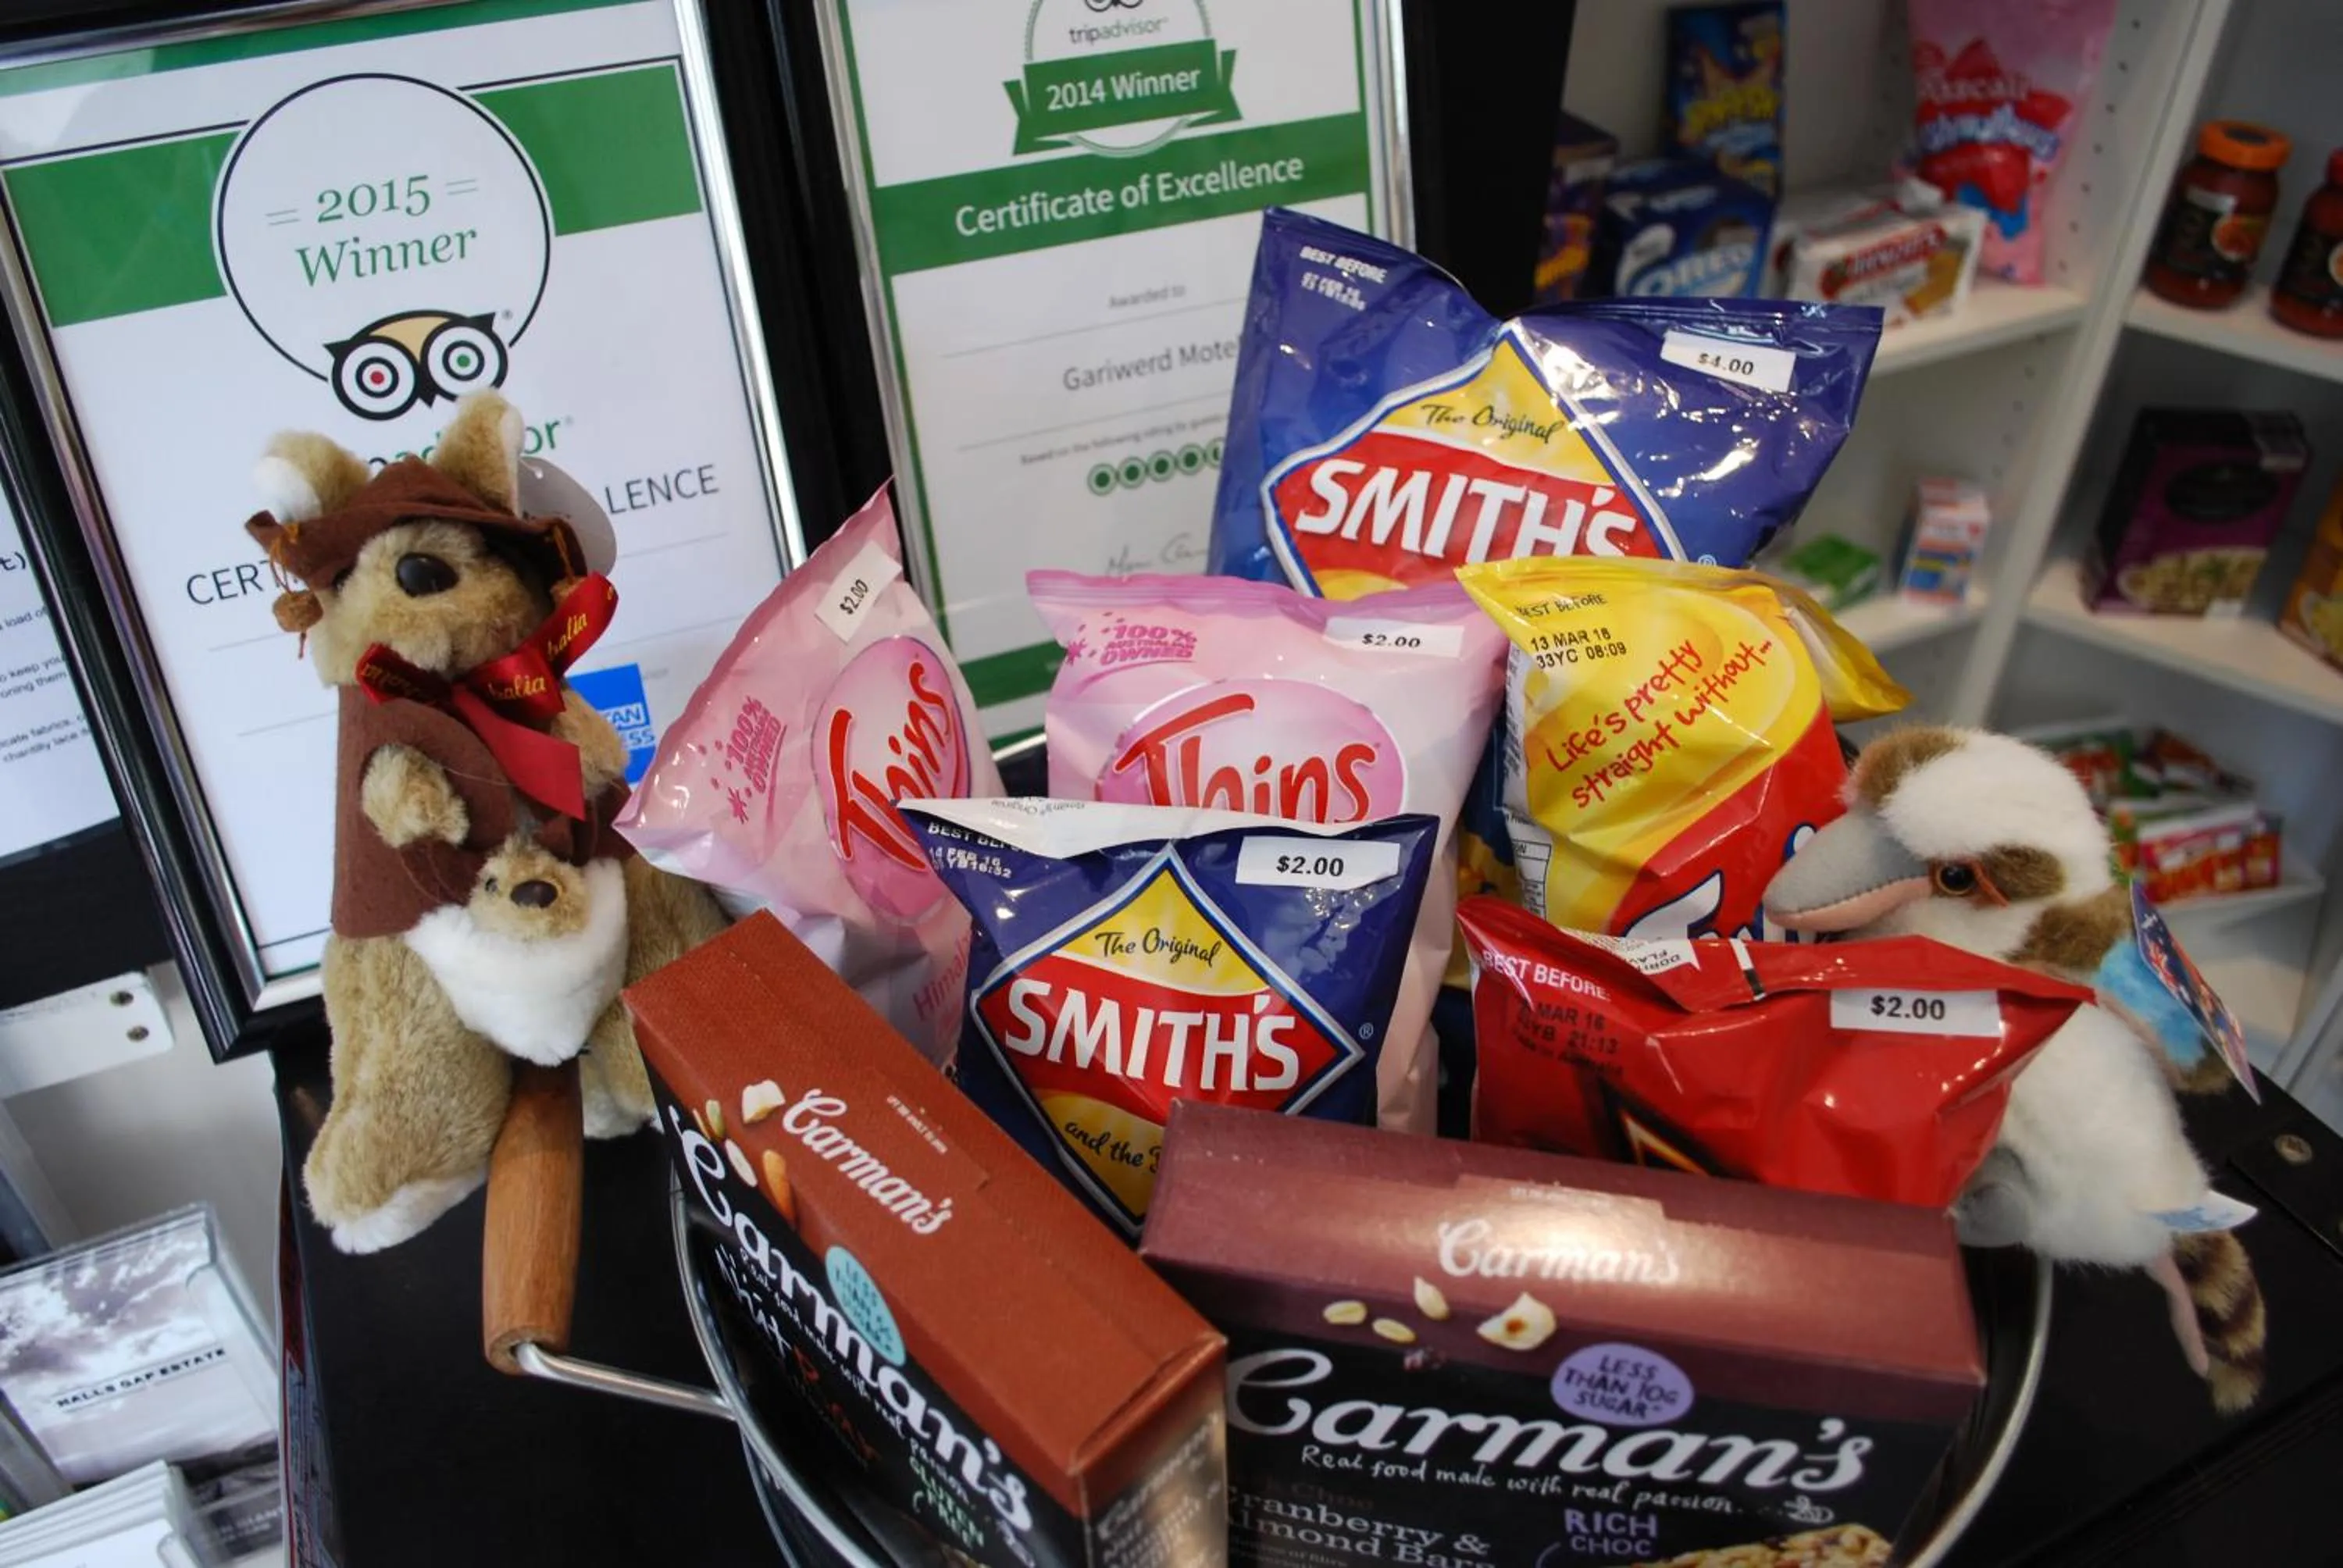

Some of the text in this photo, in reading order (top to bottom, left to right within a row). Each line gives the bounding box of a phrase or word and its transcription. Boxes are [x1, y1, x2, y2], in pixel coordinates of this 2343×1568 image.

[1069, 17, 1168, 45] tripadvisor
[1047, 68, 1200, 109] 2014 Winner
[316, 175, 432, 223] 2015
[956, 158, 1304, 236] Certificate of Excellence
[295, 228, 476, 287] Winner
[1109, 285, 1186, 308] Awarded to
[1063, 349, 1172, 391] Gariwerd
[1697, 350, 1754, 376] $4.00
[1421, 403, 1568, 445] The Original
[1296, 459, 1638, 562] SMITH'S
[840, 579, 870, 615] $2.00
[1114, 624, 1197, 643] 100%
[1362, 633, 1421, 649] $2.00
[1531, 636, 1549, 652] 13
[1553, 629, 1590, 648] MAR
[1585, 641, 1627, 660] 08:09
[1100, 647, 1193, 666] OWNED
[1547, 712, 1626, 774] Life's
[1625, 639, 1705, 724] pretty
[726, 694, 762, 764] 100%
[752, 715, 781, 794] OWNED
[829, 661, 953, 873] Thins
[1113, 692, 1376, 825] Thins
[1573, 719, 1681, 809] straight
[929, 822, 969, 841] BEST
[1276, 857, 1343, 877] $2.00
[1096, 928, 1221, 968] The Original
[1483, 950, 1531, 981] BEST
[1870, 993, 1945, 1020] $2.00
[1005, 978, 1300, 1092] SMITH'S
[782, 1089, 954, 1235] Carman's
[1065, 1121, 1109, 1156] and
[1110, 1138, 1145, 1172] the
[1438, 1218, 1679, 1286] Carman's
[669, 1104, 1034, 1532] Carman's
[56, 1348, 226, 1408] HALLS GAP ESTATE
[1564, 1367, 1628, 1395] THAN
[1599, 1354, 1659, 1381] LESS
[1226, 1348, 1873, 1493] Carman's
[1301, 1444, 1364, 1470] Real
[1371, 1459, 1428, 1484] food
[1435, 1463, 1497, 1488] made
[1505, 1474, 1561, 1497] with
[1571, 1481, 1631, 1504] real
[1229, 1509, 1382, 1558] lmond
[1564, 1509, 1658, 1538] RICH
[1453, 1533, 1491, 1557] &
[1570, 1536, 1653, 1557] CHOC
